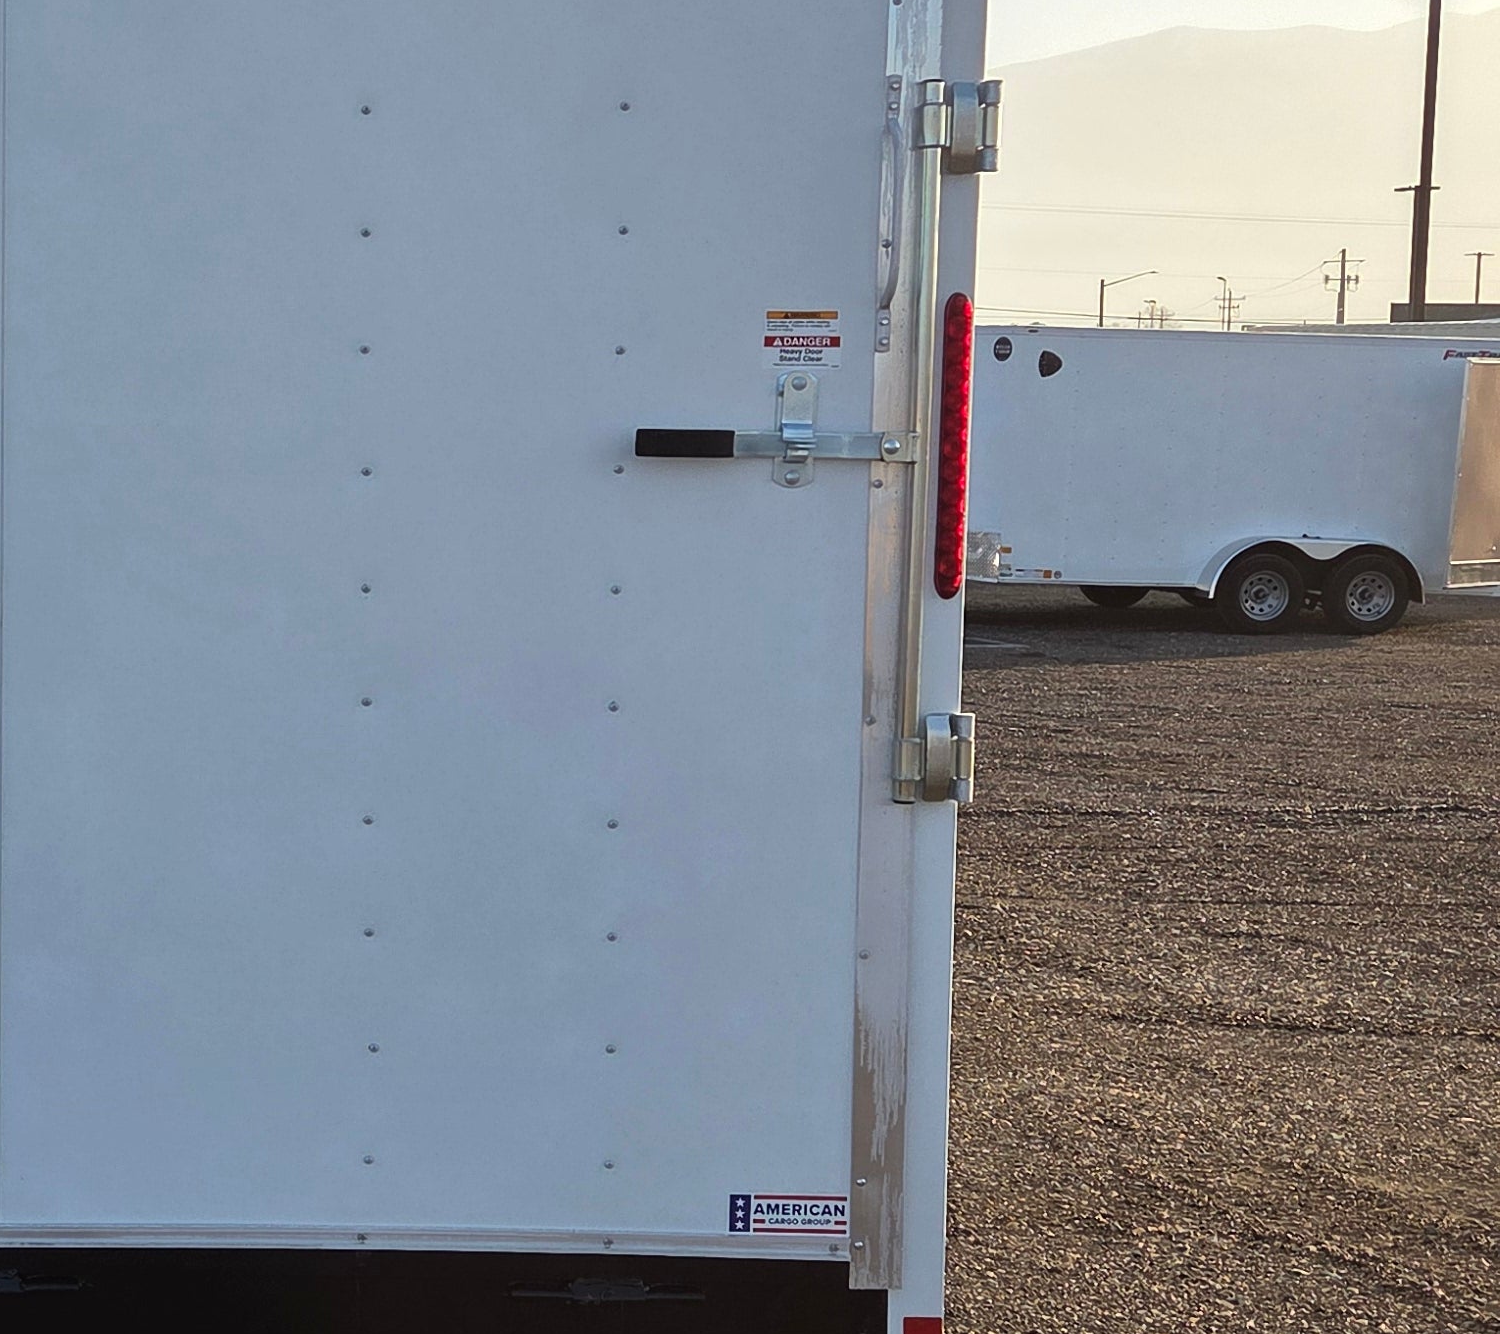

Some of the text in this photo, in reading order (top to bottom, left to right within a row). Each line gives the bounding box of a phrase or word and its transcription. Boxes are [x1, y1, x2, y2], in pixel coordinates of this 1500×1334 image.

[783, 337, 831, 346] DANGER
[779, 348, 803, 356] Heavy
[753, 1203, 845, 1217] AMERICAN
[801, 1218, 832, 1226] GROUP
